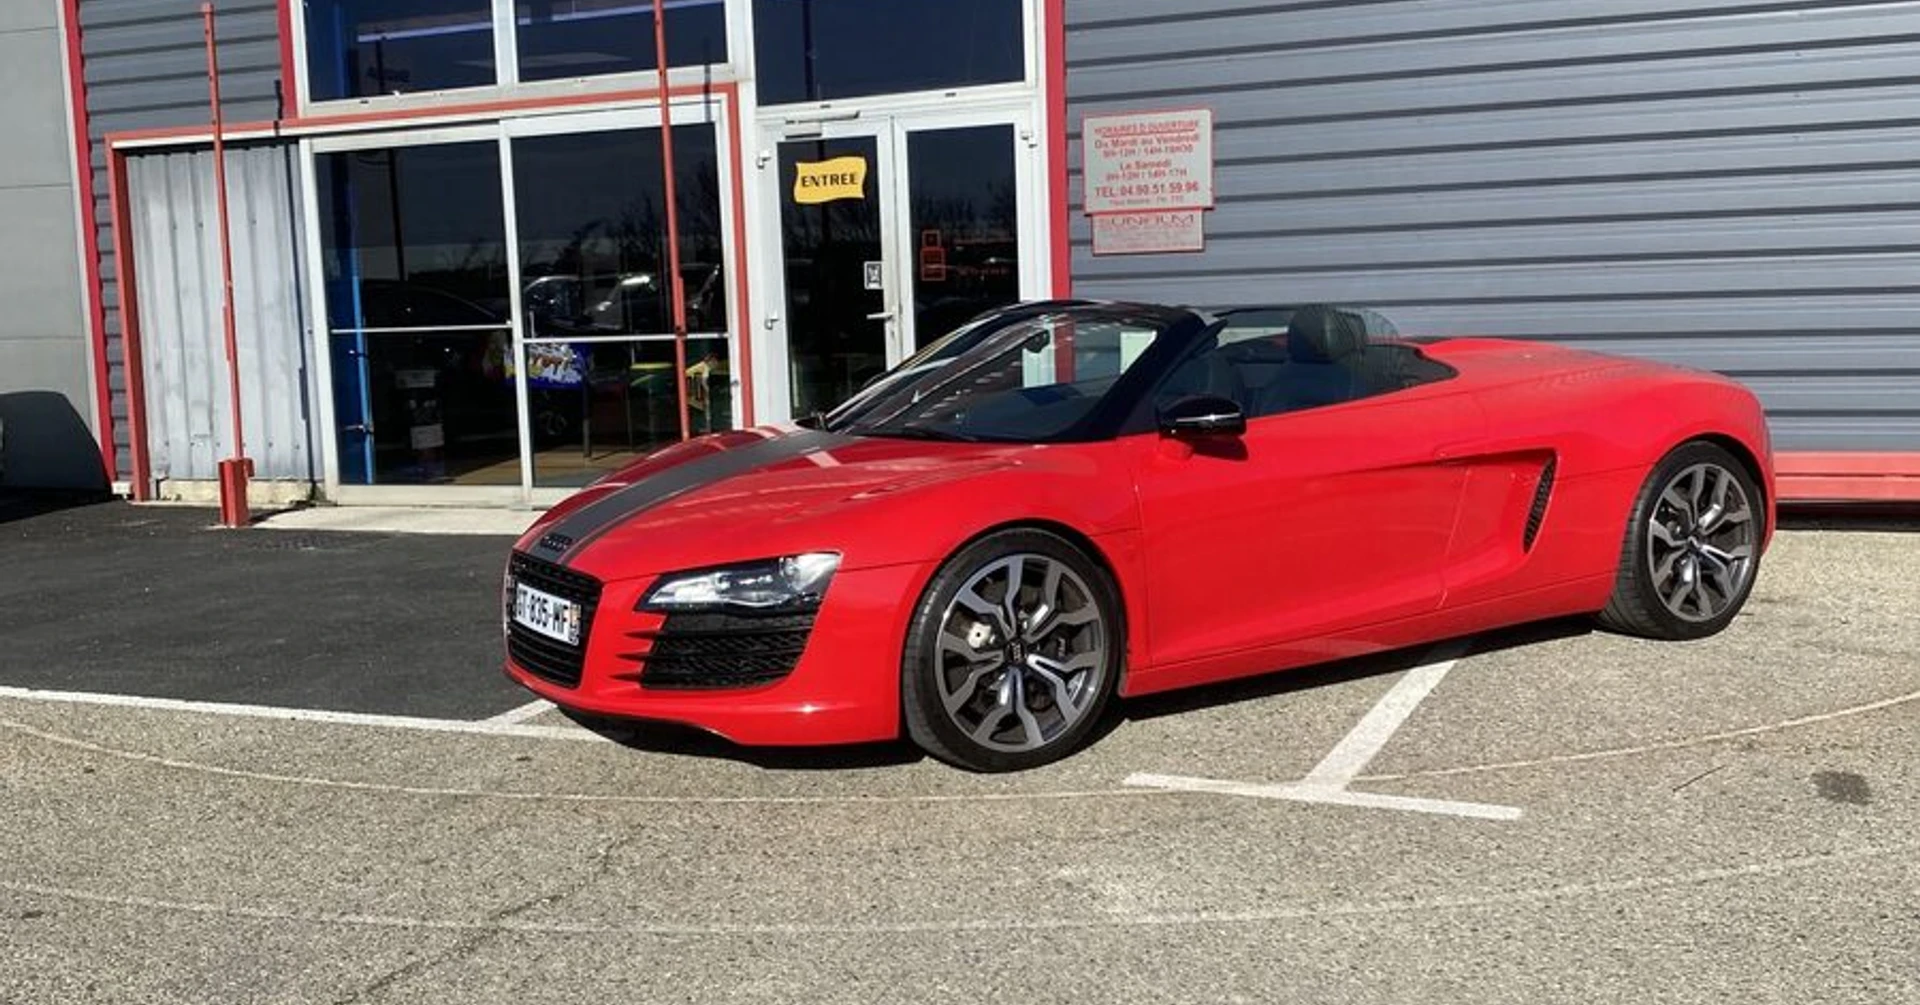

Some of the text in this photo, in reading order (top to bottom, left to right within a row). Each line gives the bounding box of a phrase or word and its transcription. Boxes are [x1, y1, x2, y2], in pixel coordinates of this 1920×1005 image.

[1111, 137, 1138, 148] Mardi
[1155, 133, 1200, 145] Vendredi
[1120, 158, 1172, 171] Le Samedi
[801, 172, 859, 188] ENTREE
